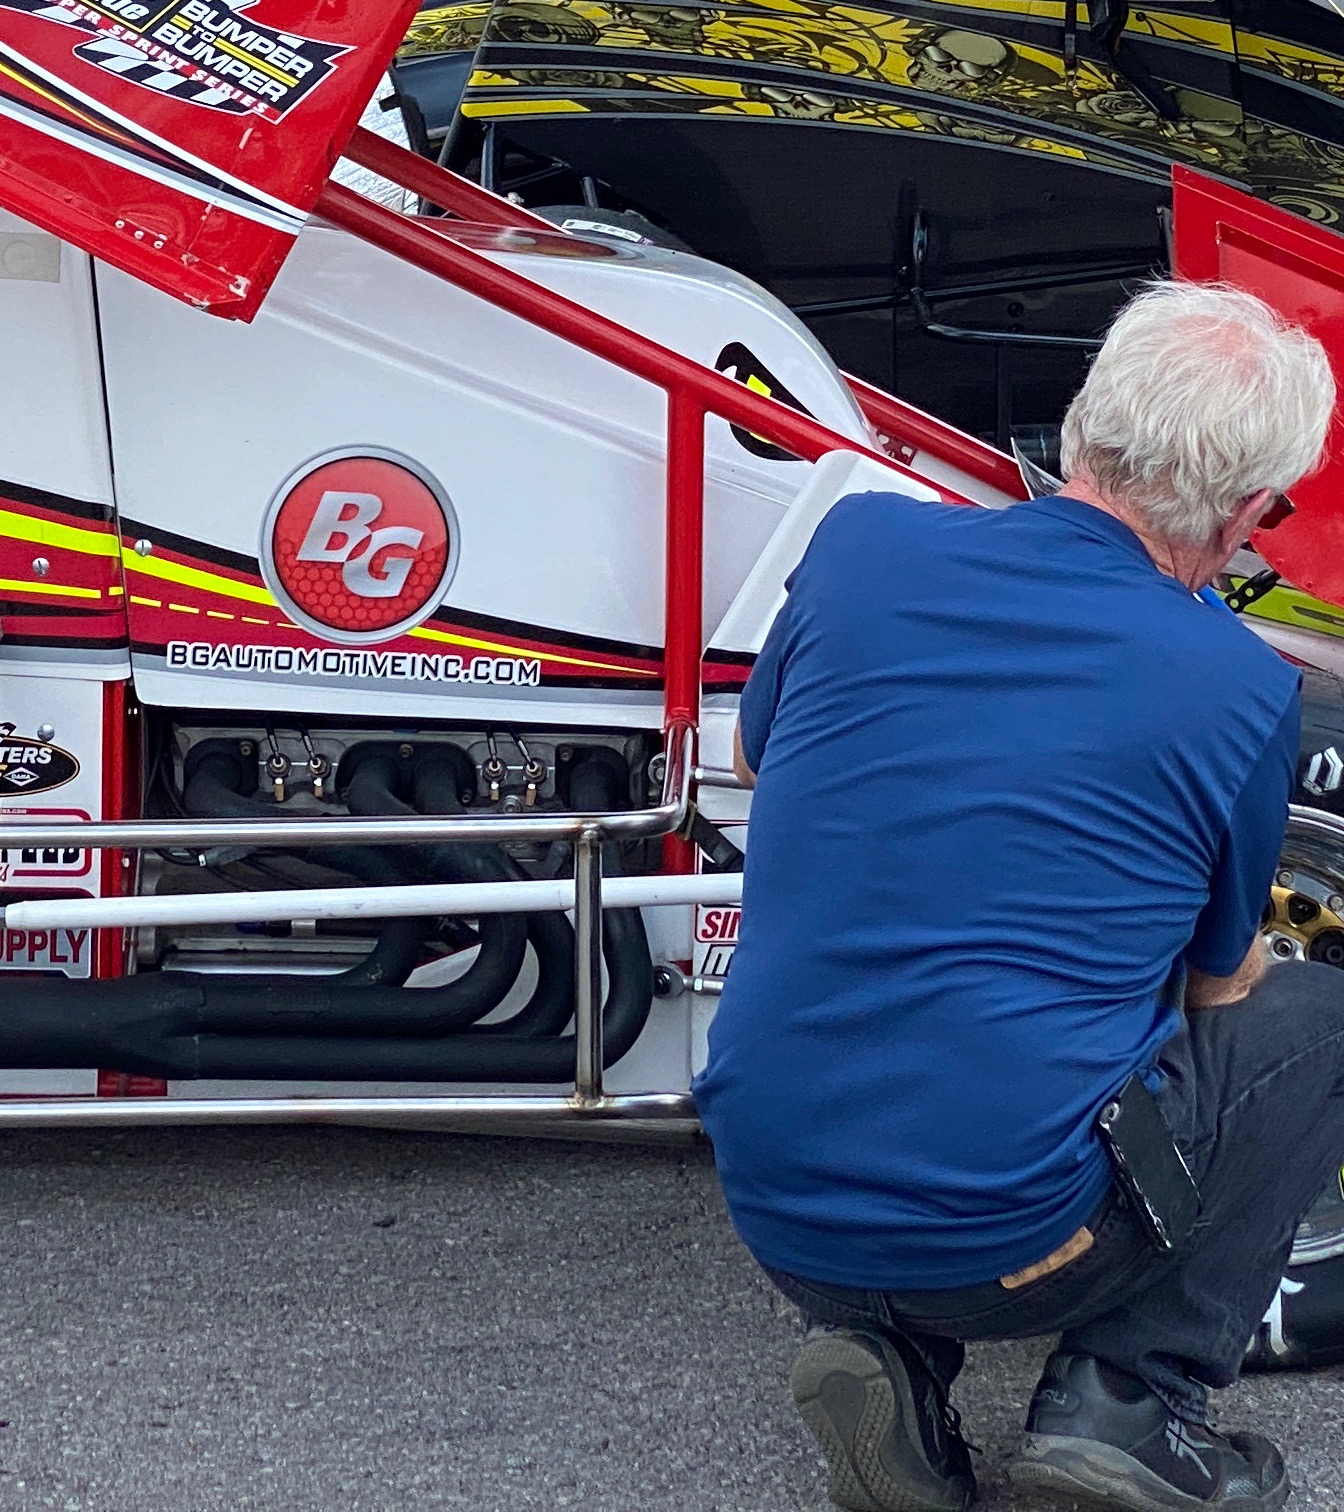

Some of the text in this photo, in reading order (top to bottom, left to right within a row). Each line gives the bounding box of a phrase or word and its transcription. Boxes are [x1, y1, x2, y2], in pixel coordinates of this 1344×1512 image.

[108, 24, 191, 72] SPRINT
[189, 68, 271, 114] SERIES
[152, 22, 289, 103] BUMPER
[178, 0, 315, 79] BUMPER
[190, 27, 215, 43] TO
[296, 490, 424, 598] BG
[167, 642, 541, 687] BGAUTOMOTIVEINC.COM
